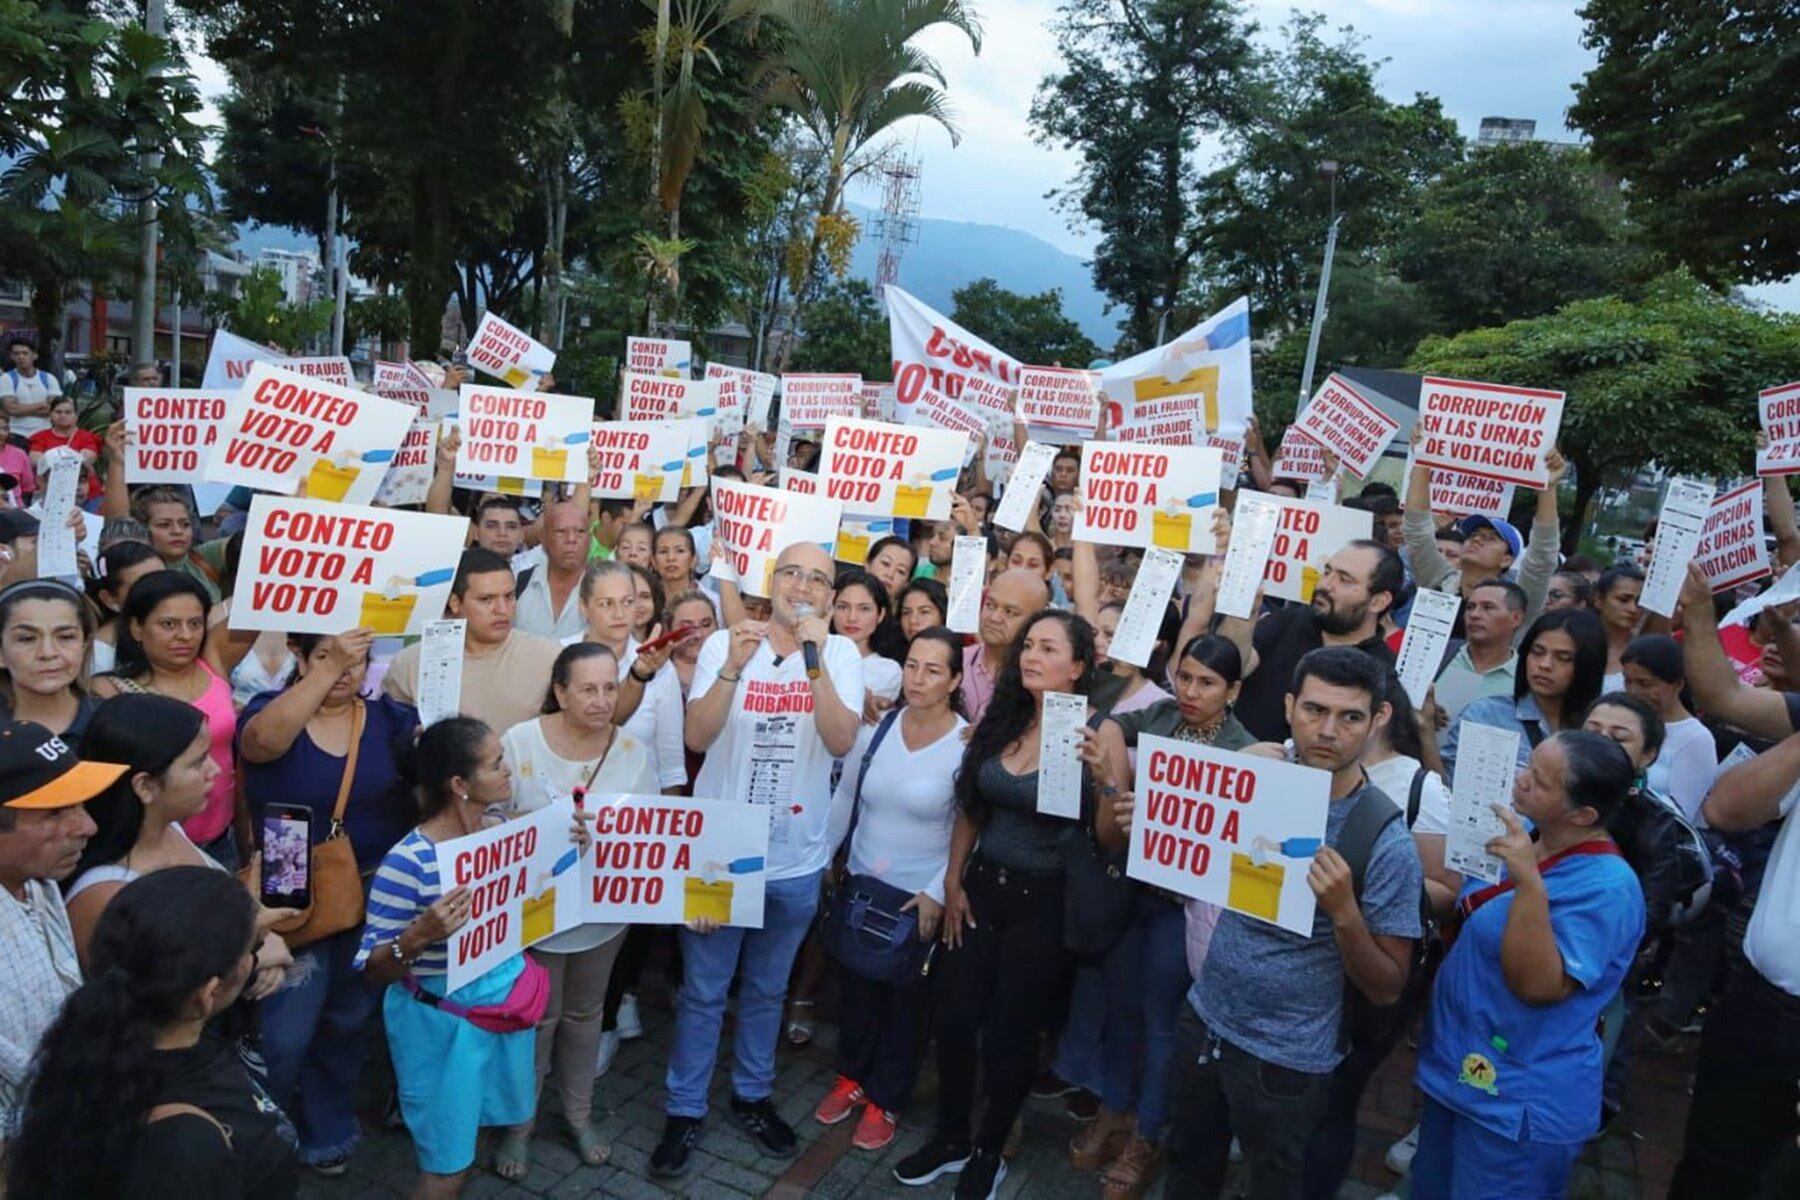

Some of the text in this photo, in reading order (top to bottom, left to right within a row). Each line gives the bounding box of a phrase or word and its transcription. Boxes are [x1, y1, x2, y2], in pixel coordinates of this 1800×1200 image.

[480, 333, 522, 364] VOTO A
[486, 320, 530, 353] CONTEO
[631, 342, 668, 356] CONTEO
[300, 362, 348, 377] FRAUDE
[472, 346, 504, 370] VOTO
[631, 355, 665, 369] VOTO A
[631, 379, 686, 399] CONTEO
[967, 376, 984, 391] NO
[984, 383, 995, 395] AL
[1022, 388, 1034, 400] EN
[1036, 389, 1056, 402] LAS
[1058, 391, 1094, 406] URNAS
[137, 397, 226, 421] CONTEO
[254, 378, 359, 427] CONTEO
[470, 394, 546, 419] CONTEO
[630, 396, 679, 414] VOTO A
[922, 391, 938, 406] NO
[936, 400, 949, 412] AL
[1024, 402, 1037, 415] DE
[1134, 405, 1147, 419] NO
[1148, 403, 1158, 415] AL
[1161, 398, 1200, 413] FRAUDE
[1428, 393, 1546, 425] CORRUPCIÓN
[239, 408, 336, 455] VOTO A
[469, 418, 538, 443] VOTO A
[1119, 419, 1193, 442] NO AL FRAUDE
[1306, 415, 1325, 430] DE
[1312, 399, 1379, 453] EN LAS URNAS
[1424, 415, 1544, 448] EN LAS URNAS
[1769, 423, 1785, 441] EN
[138, 424, 217, 447] VOTO A
[834, 426, 918, 457] CONTEO
[138, 449, 198, 471] VOTO
[224, 438, 298, 475] VOTO
[467, 441, 519, 465] VOTO
[628, 453, 640, 471] A
[1089, 451, 1168, 478] CONTEO
[1425, 438, 1536, 472] DE VOTACIÓN
[832, 452, 904, 481] VOTO A
[1282, 461, 1294, 471] DE
[827, 478, 881, 503] VOTO
[1087, 477, 1157, 506] VOTO A
[1429, 470, 1505, 494] LAS URNAS
[1432, 489, 1501, 511] VOTACIÓN
[263, 509, 394, 552] CONTEO
[1085, 506, 1137, 531] VOTO
[1283, 507, 1320, 534] TEO
[757, 529, 772, 552] A
[1714, 520, 1755, 550] URNAS
[1294, 538, 1308, 561] A
[258, 545, 375, 585] VOTO A
[251, 582, 338, 616] VOTO
[743, 693, 814, 714] ROBANDO
[1148, 751, 1256, 804] CONTEO
[596, 806, 704, 838] CONTEO
[1147, 789, 1239, 844] VOTO A
[455, 826, 537, 886] CONTEO
[593, 841, 690, 871] VOTO A
[1143, 827, 1211, 876] VOTO
[472, 866, 527, 920] OTO A
[592, 875, 664, 905] VOTO
[458, 911, 508, 966] VOTO
